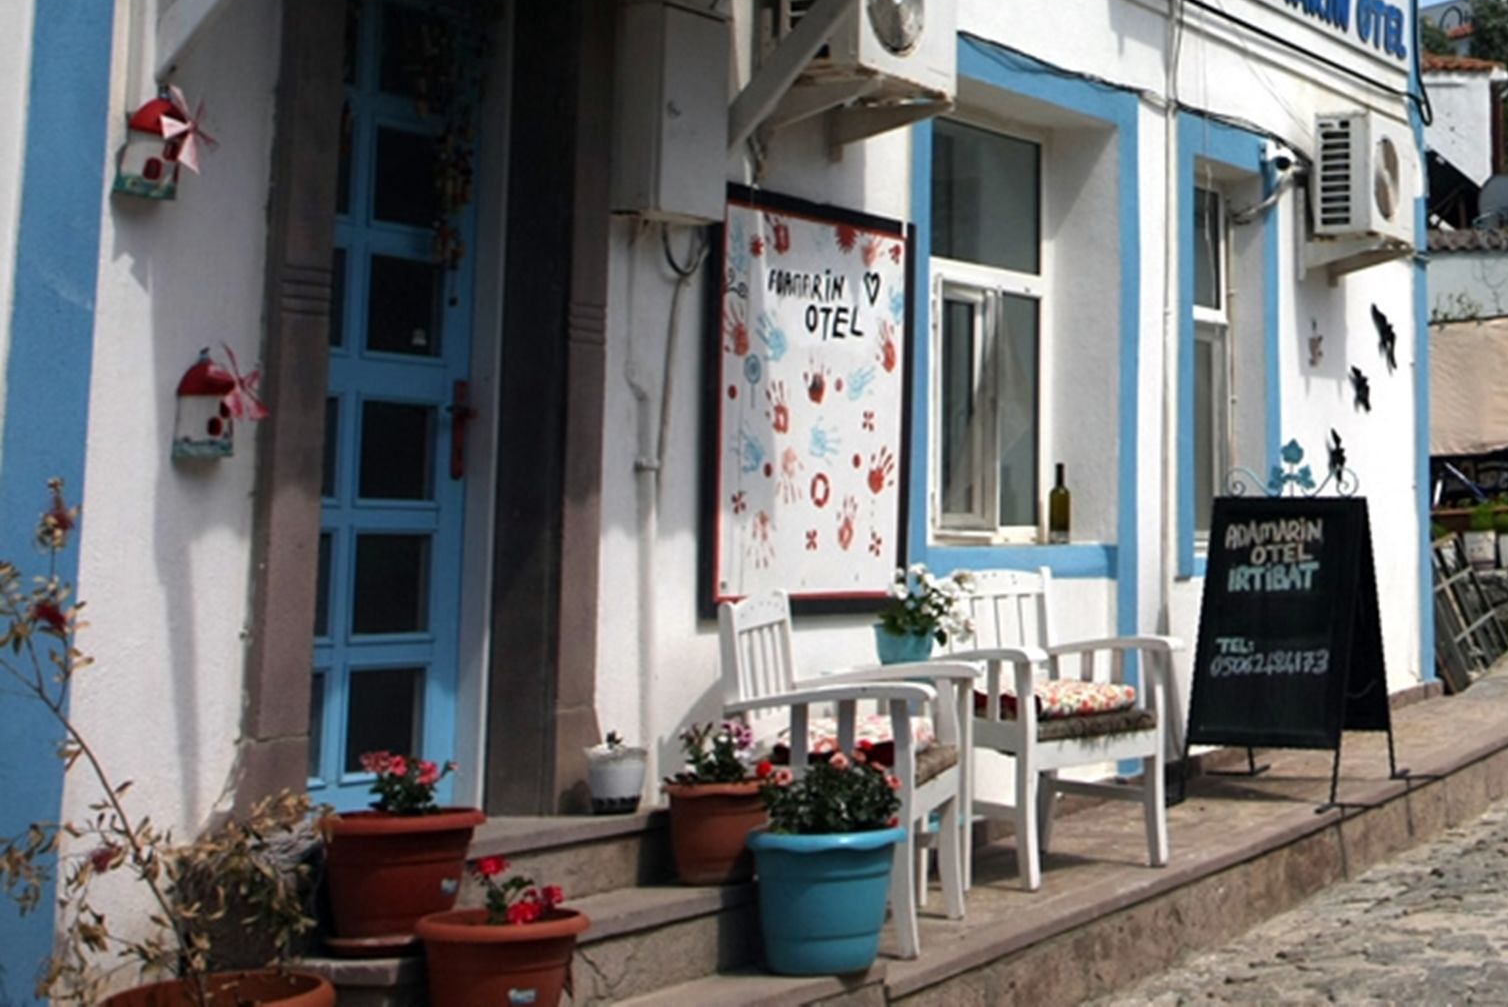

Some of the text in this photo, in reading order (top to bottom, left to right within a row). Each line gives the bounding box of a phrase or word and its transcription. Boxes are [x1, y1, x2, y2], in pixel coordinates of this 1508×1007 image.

[805, 304, 864, 341] OTEL
[1251, 544, 1313, 564] OTEL
[1215, 637, 1255, 655] TEL:
